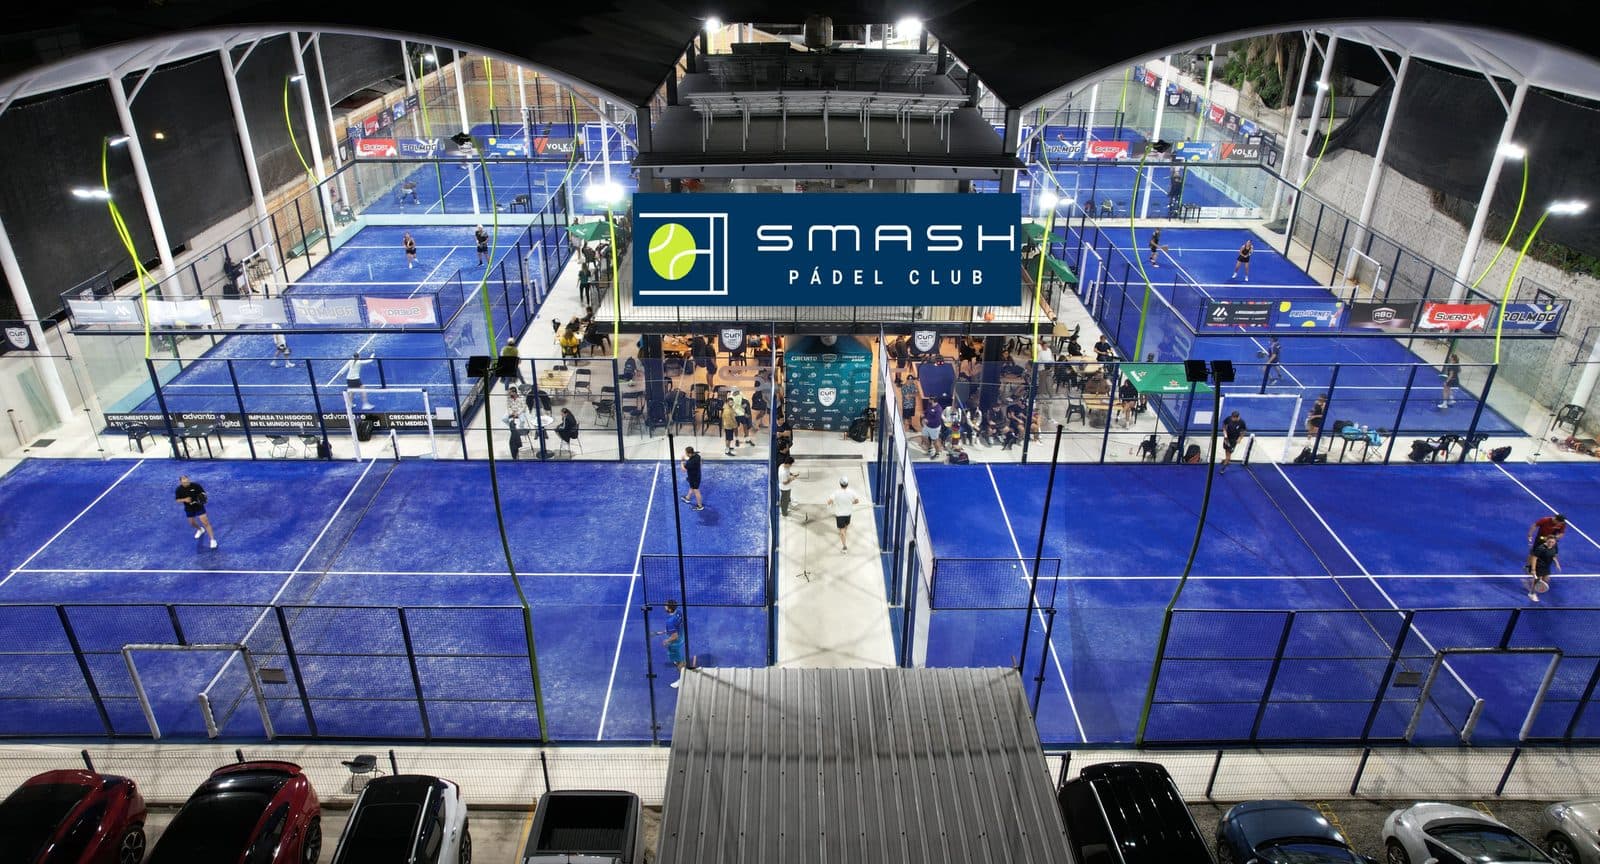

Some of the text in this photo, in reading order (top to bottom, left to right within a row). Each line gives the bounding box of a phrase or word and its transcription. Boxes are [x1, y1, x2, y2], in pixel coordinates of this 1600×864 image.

[756, 224, 1015, 251] SMASH
[788, 266, 983, 285] PÁDEL CLUB
[1502, 312, 1556, 322] ROLMOG
